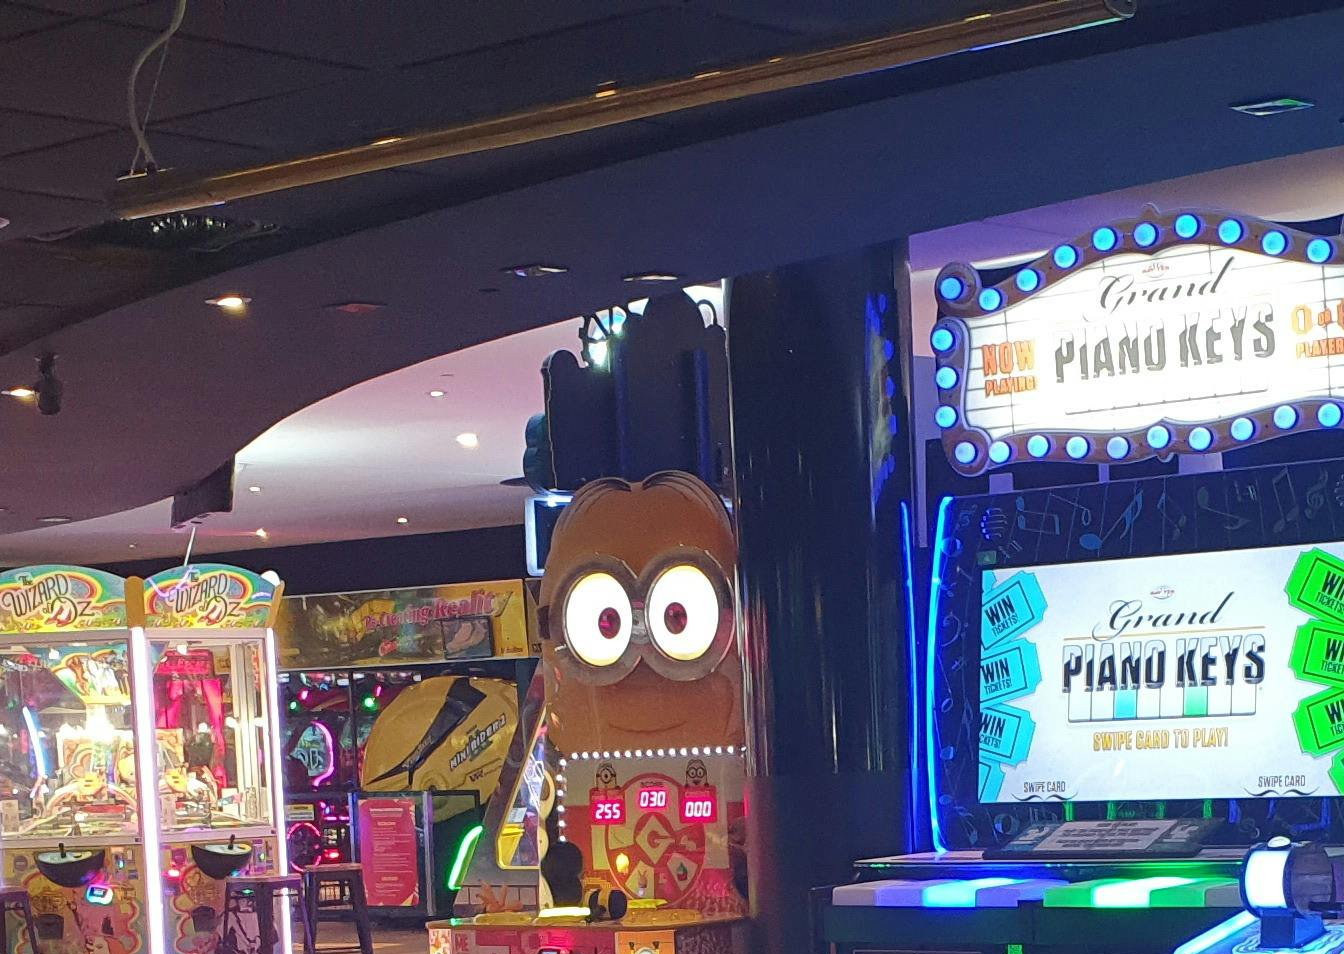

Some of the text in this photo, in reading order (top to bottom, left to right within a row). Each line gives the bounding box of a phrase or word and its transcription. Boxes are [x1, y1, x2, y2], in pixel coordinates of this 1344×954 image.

[1098, 255, 1236, 315] Grand
[981, 339, 1035, 377] NOW
[1055, 303, 1276, 383] PIANO KEYS
[2, 573, 70, 618] WIZARD
[168, 573, 229, 614] WIZARD
[51, 596, 95, 627] OZ
[205, 595, 241, 625] OZ
[984, 595, 1016, 626] WIN
[1092, 591, 1235, 641] Grand
[992, 614, 1020, 638] TICKETS!
[982, 657, 1011, 685] WIN
[1062, 633, 1266, 693] PIANO KEYS
[984, 679, 1012, 696] TICKETS!
[1093, 727, 1229, 752] SWIPE CARD TO PLAY!
[1023, 780, 1066, 794] SWIPE CARD
[1258, 774, 1306, 788] SWIPE CARD
[595, 803, 621, 820] 255
[639, 791, 667, 808] 030
[684, 800, 712, 818] 000
